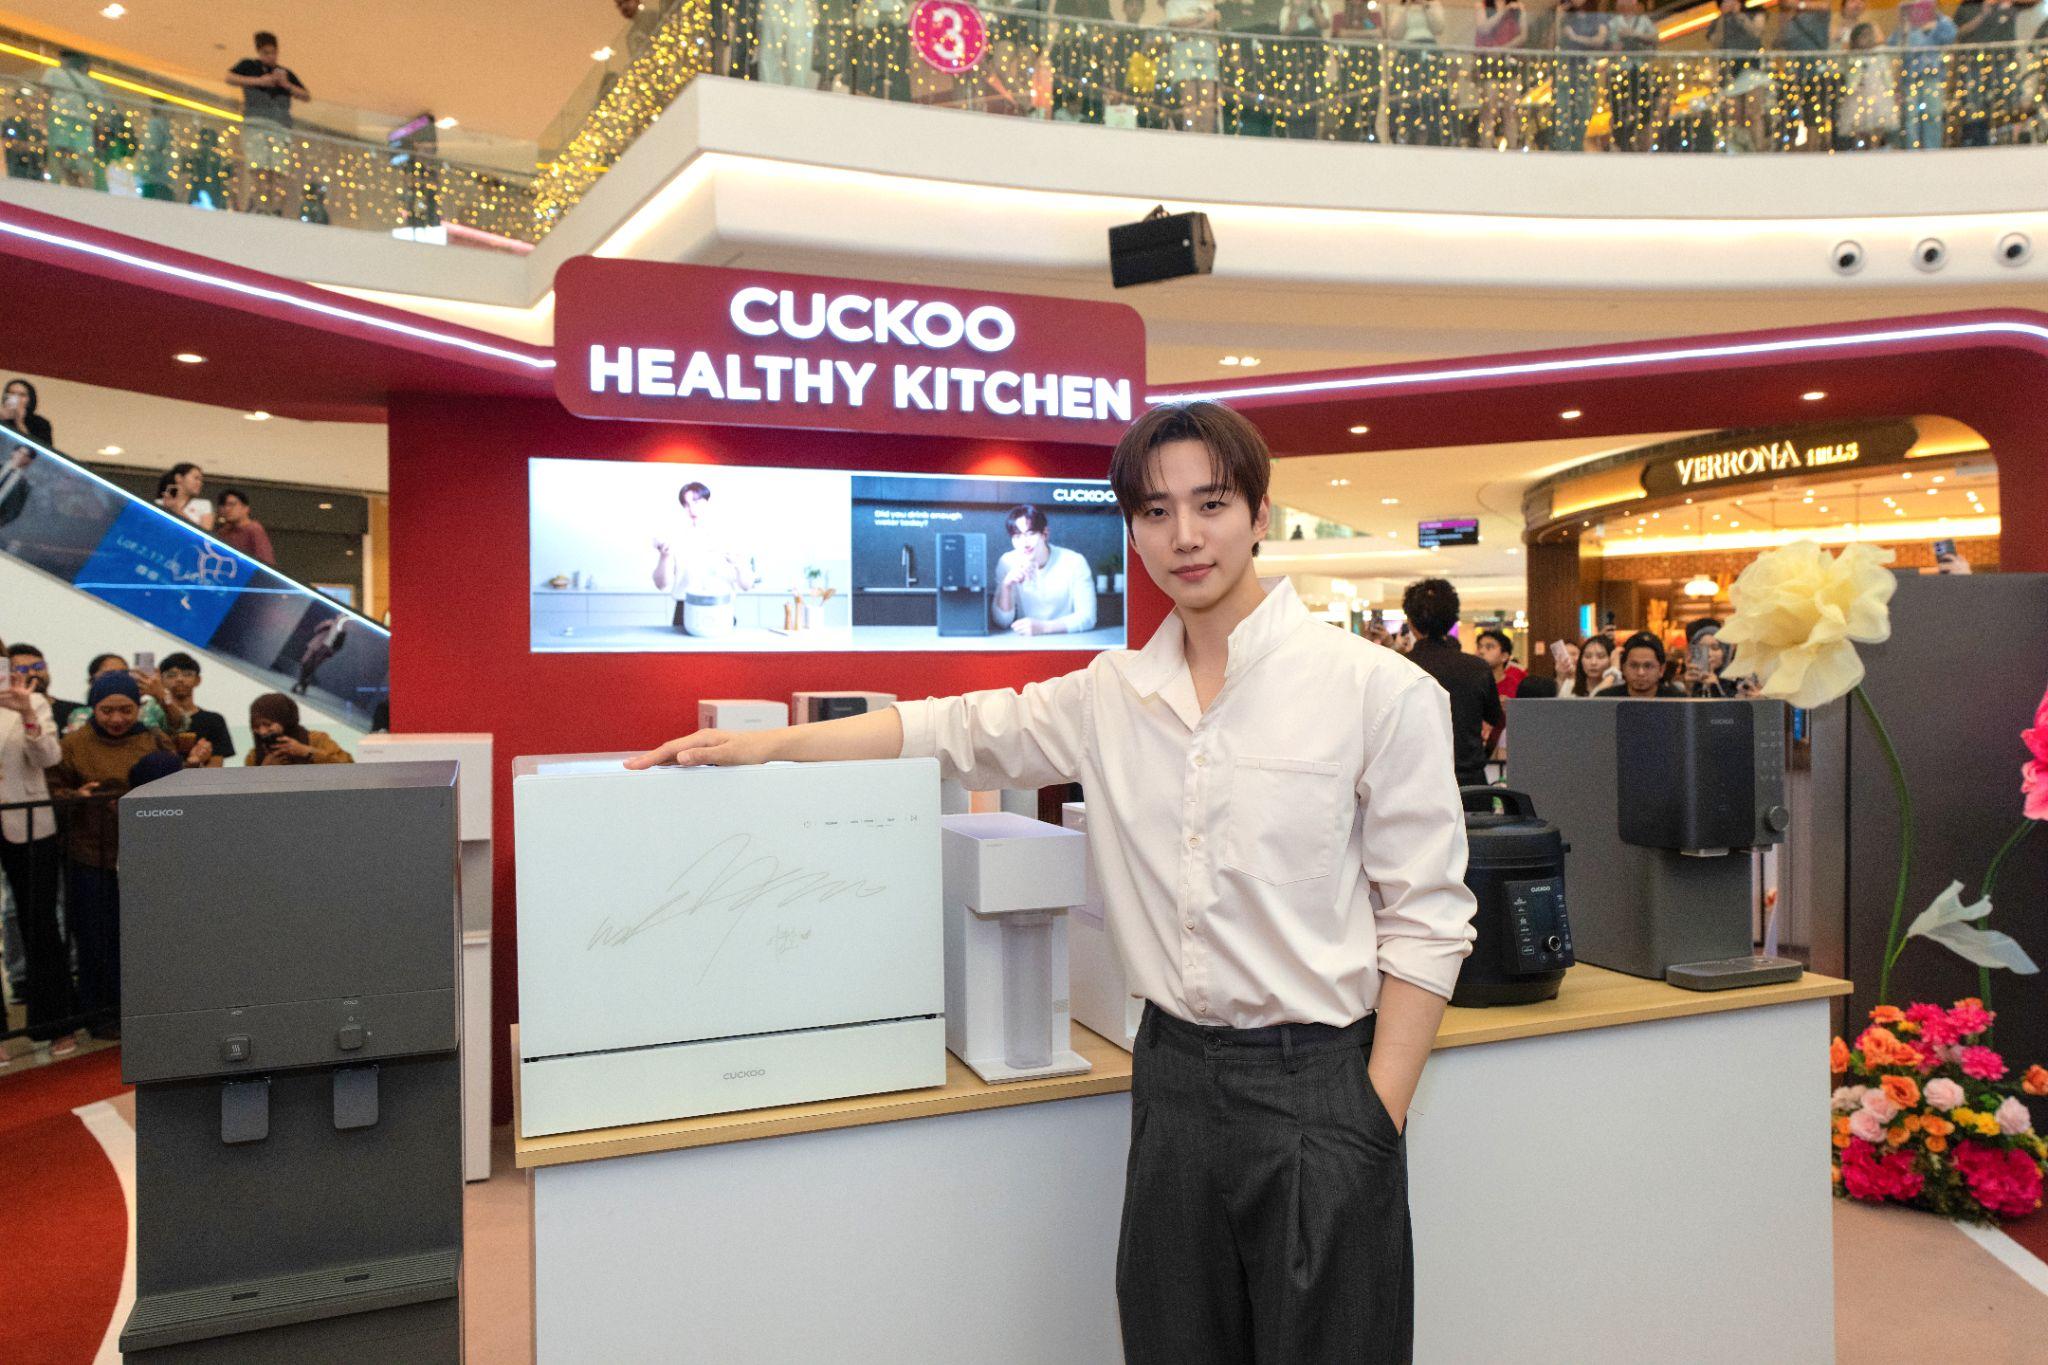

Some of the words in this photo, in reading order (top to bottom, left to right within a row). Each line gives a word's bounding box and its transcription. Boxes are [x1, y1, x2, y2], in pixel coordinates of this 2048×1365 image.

[933, 7, 965, 60] 3
[730, 287, 1016, 352] CUCKOO
[589, 345, 876, 406] HEALTHY
[893, 365, 1131, 421] KITCHEN
[1677, 440, 1802, 486] VERRONA
[1053, 489, 1117, 503] CUCKOO
[136, 809, 184, 818] CUCKOO
[722, 1069, 766, 1080] CUCKOO
